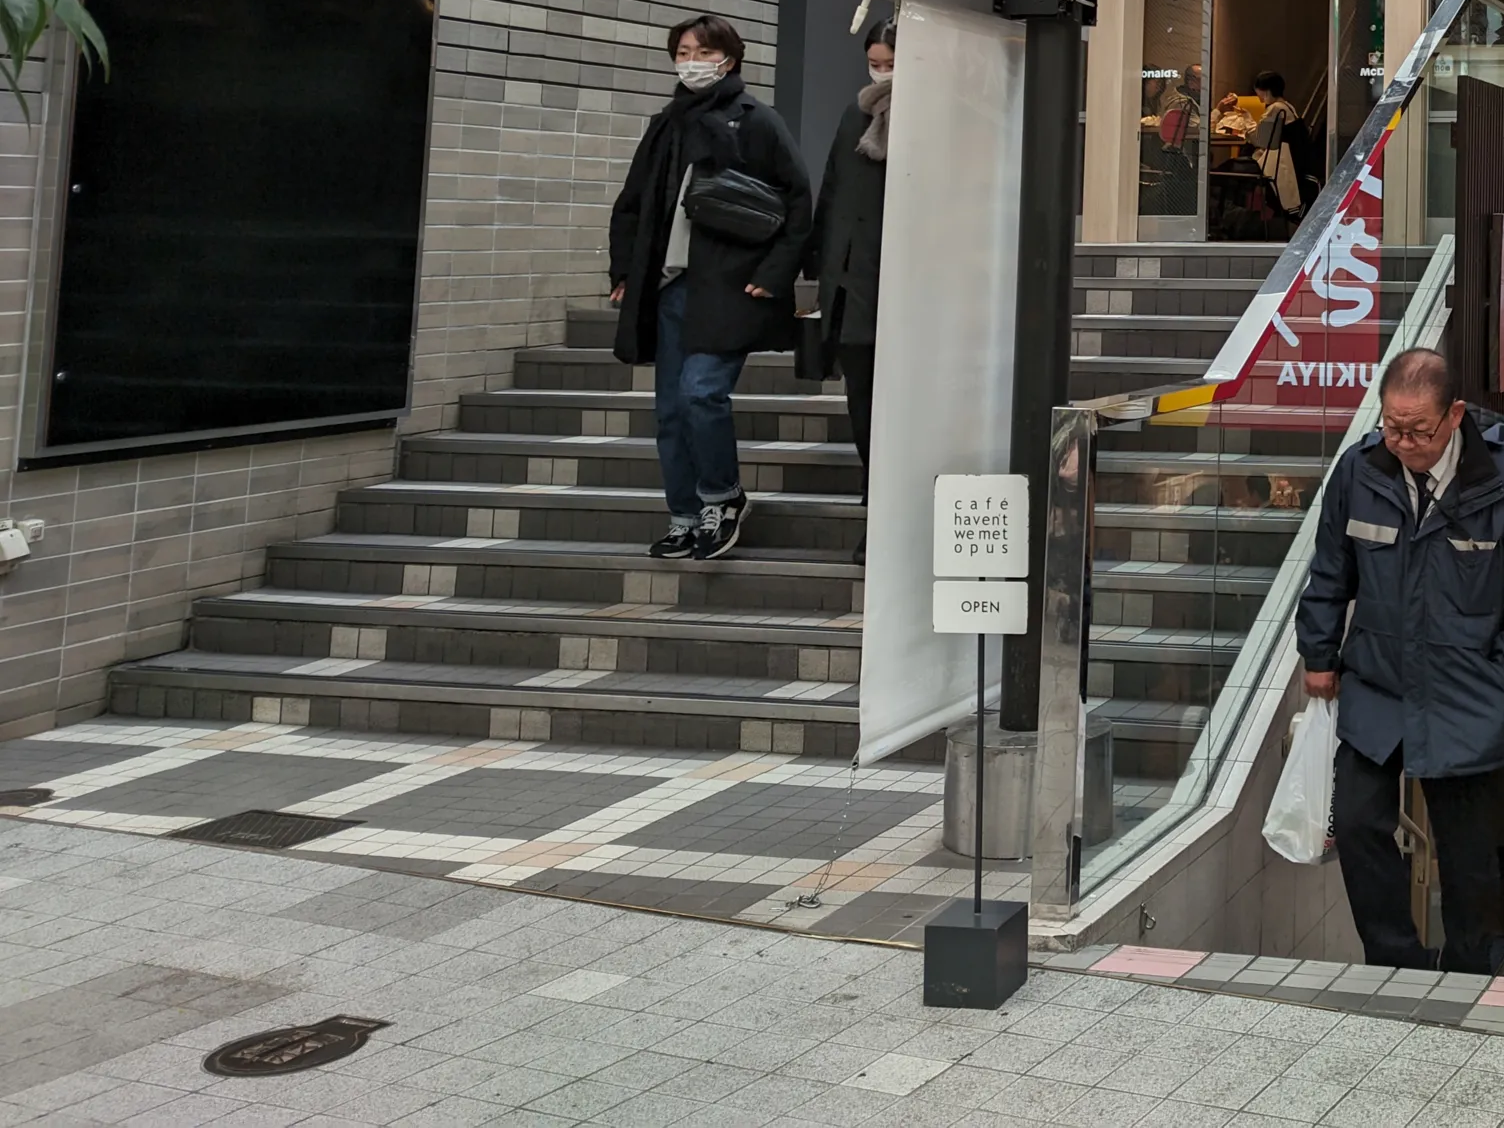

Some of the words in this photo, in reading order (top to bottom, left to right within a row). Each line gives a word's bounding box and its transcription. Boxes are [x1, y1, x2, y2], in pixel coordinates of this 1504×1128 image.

[954, 497, 1009, 510] café
[954, 513, 1009, 526] haven't
[954, 529, 975, 540] we
[978, 529, 1009, 540] met
[954, 543, 1009, 557] opus
[961, 600, 1000, 613] OPEN
